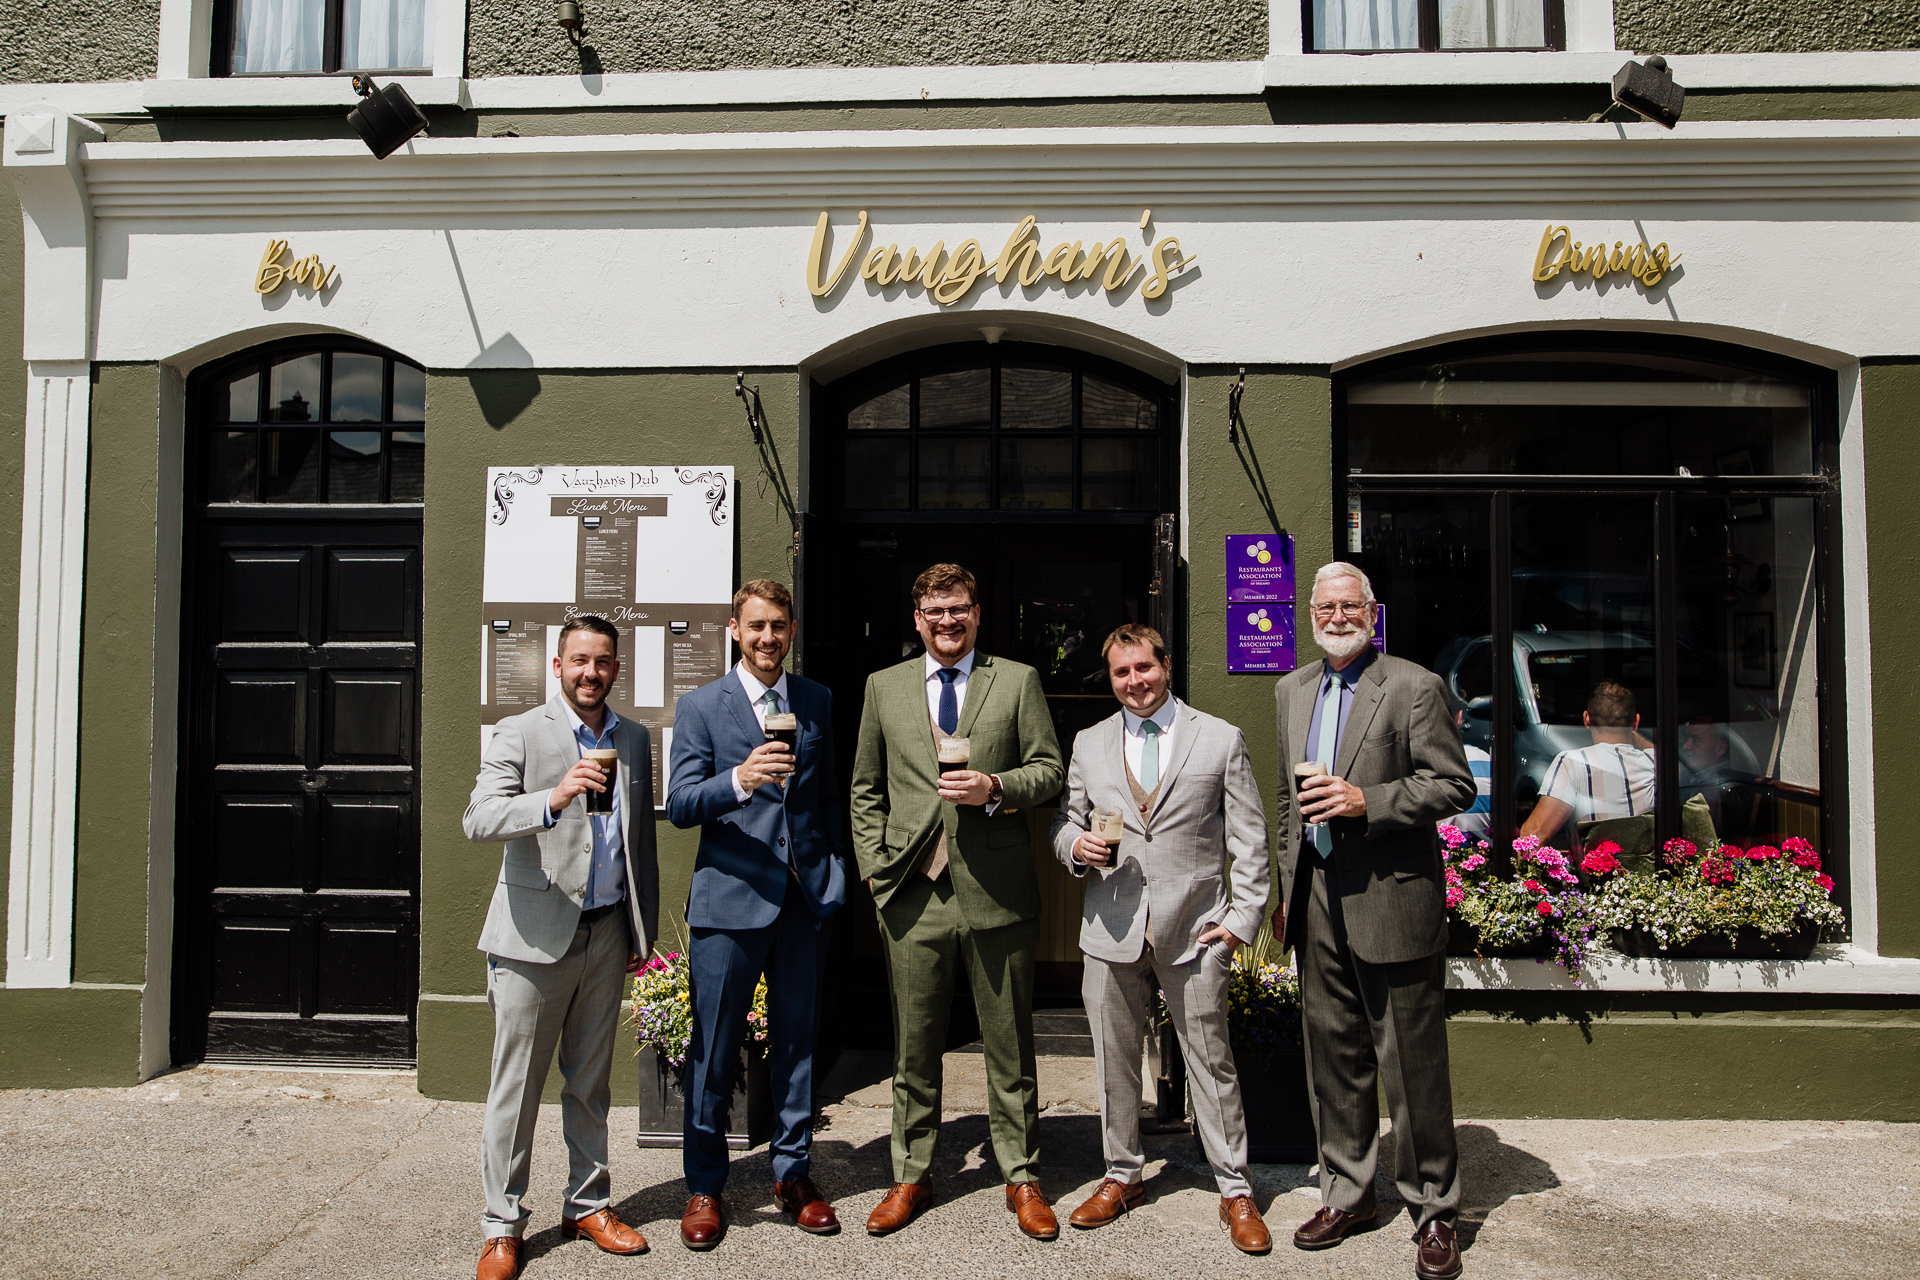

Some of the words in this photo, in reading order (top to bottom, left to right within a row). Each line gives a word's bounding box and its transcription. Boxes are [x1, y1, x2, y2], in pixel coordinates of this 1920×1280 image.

[254, 238, 336, 294] Bar
[806, 209, 1197, 304] Vaughan's
[1533, 224, 1682, 287] Dining
[561, 468, 626, 492] Vaughan's
[630, 468, 659, 489] Pub
[566, 498, 609, 515] Lunch
[609, 498, 648, 515] Menu
[563, 605, 609, 622] Evening
[609, 605, 649, 623] Menu
